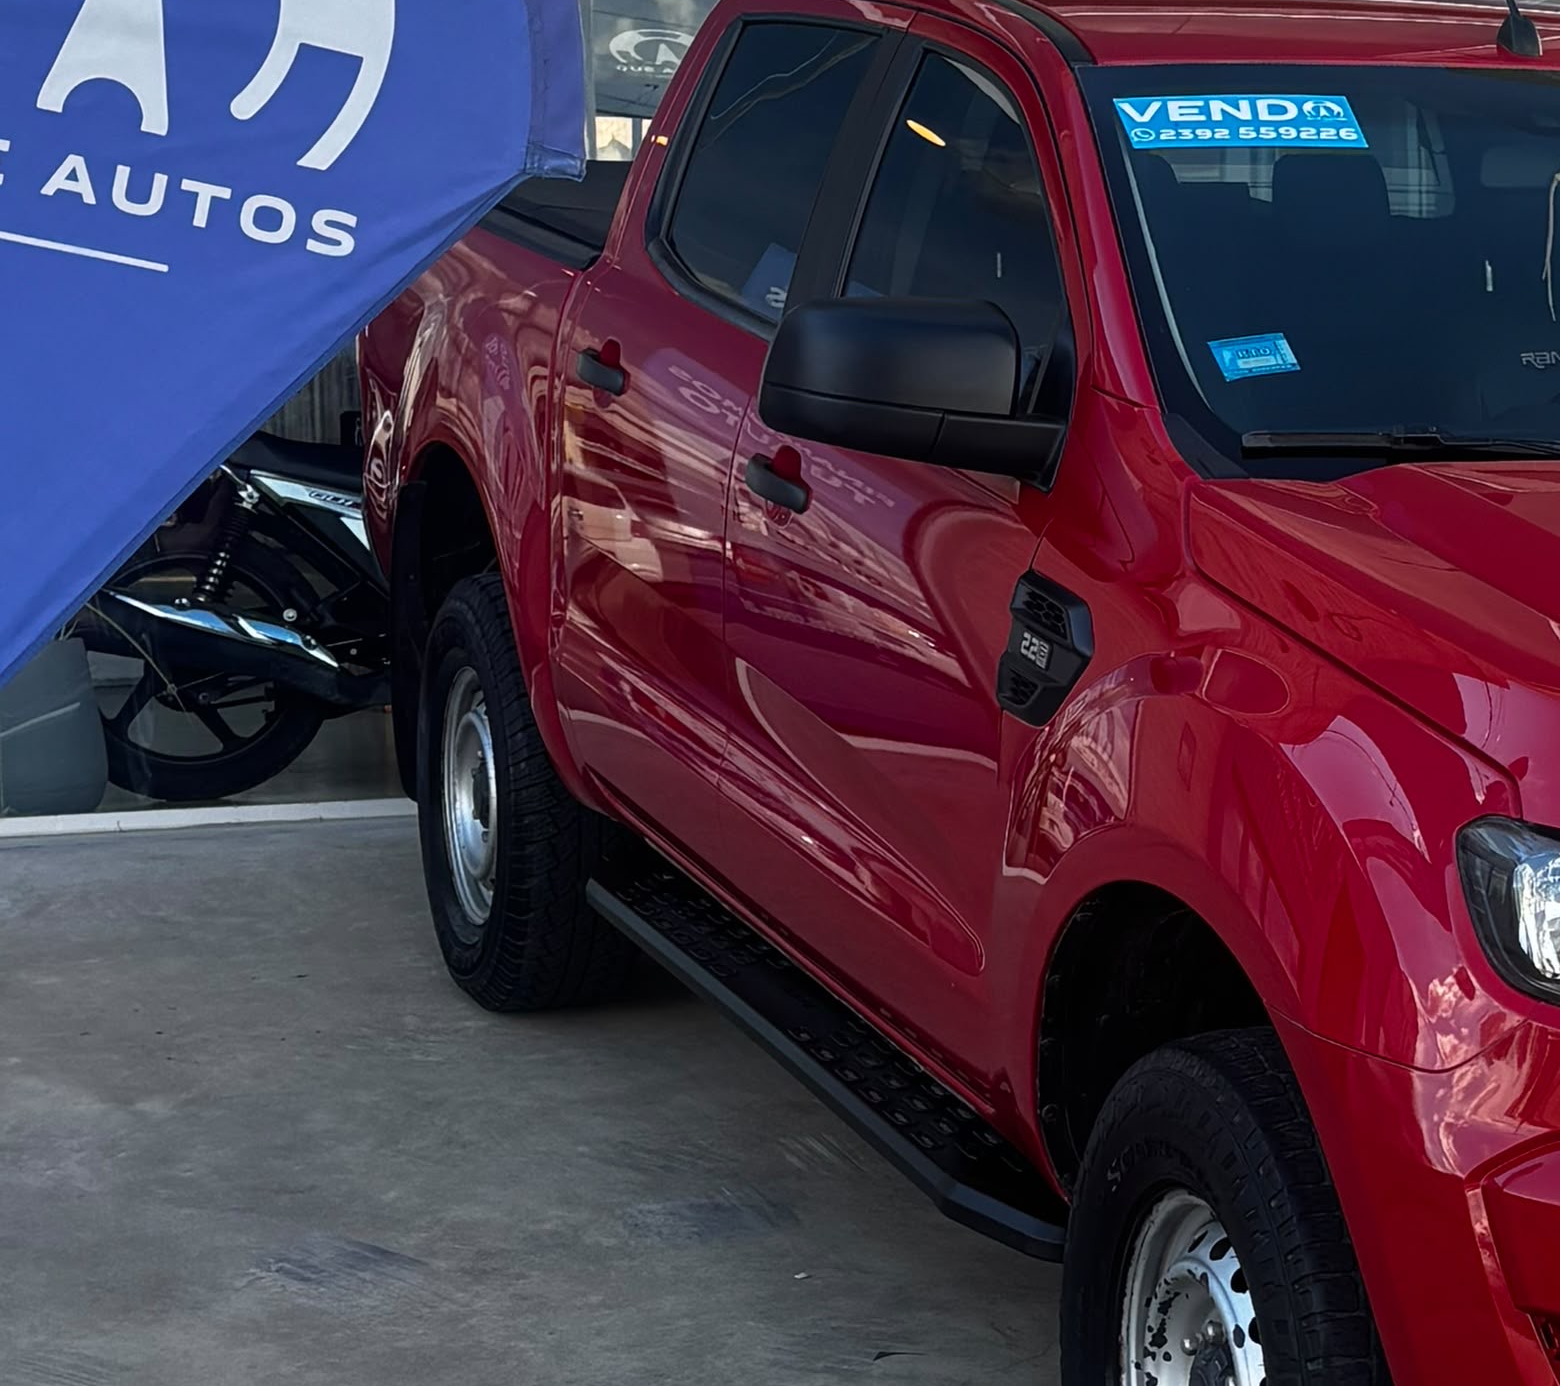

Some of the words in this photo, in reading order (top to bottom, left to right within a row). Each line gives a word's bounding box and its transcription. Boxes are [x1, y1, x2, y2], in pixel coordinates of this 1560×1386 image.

[1159, 128, 1232, 140] 2392
[1238, 126, 1358, 140] 559226
[40, 153, 358, 257] AUTOS
